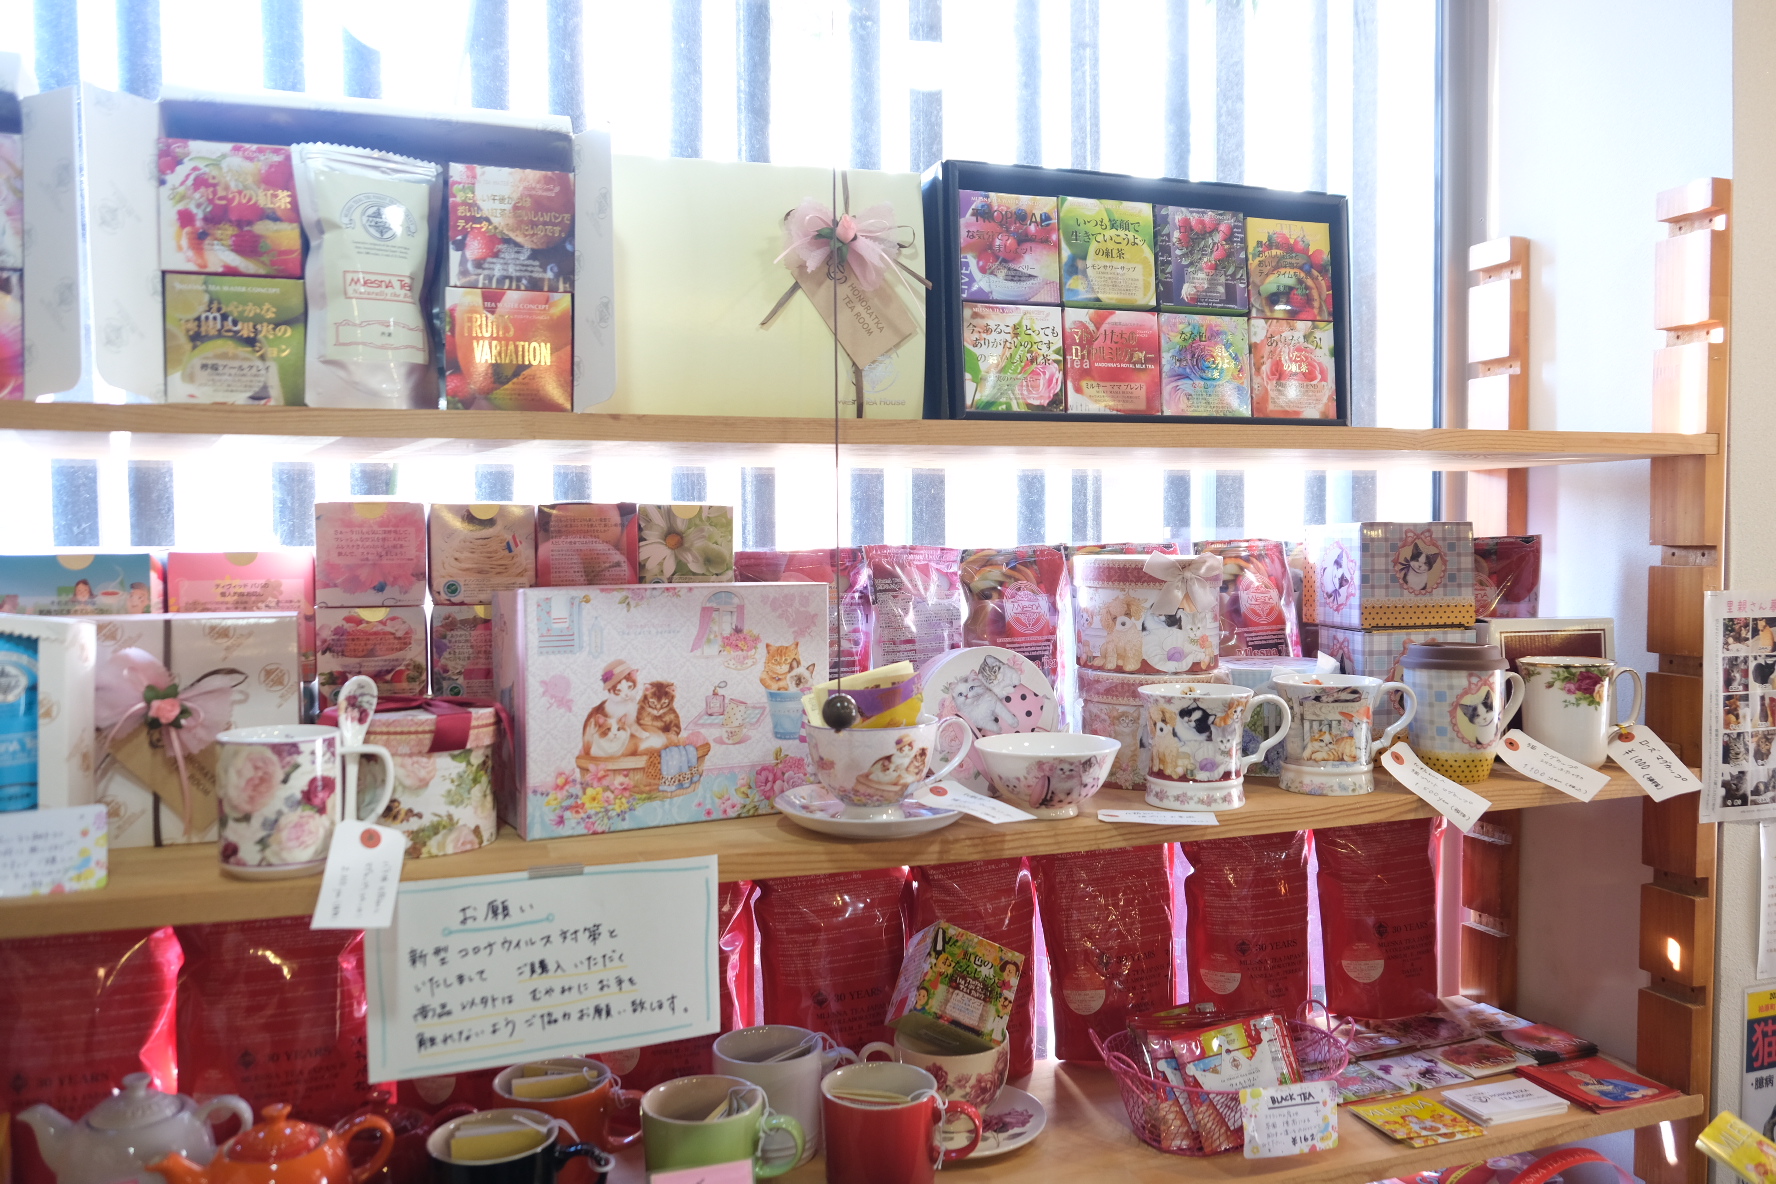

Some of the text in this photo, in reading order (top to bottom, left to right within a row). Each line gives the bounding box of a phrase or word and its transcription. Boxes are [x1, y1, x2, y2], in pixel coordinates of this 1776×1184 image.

[972, 207, 1044, 228] TROPICAL
[1076, 217, 1141, 233] いつも笑顔で
[1070, 230, 1147, 247] 生きていこうよッ
[1094, 247, 1125, 260] の紅茶
[400, 279, 412, 292] Te
[842, 294, 874, 337] TEA ROOM
[847, 283, 885, 334] HONORATKA
[463, 313, 515, 338] FRUITS
[1023, 324, 1059, 338] とっても
[972, 337, 1054, 351] ありがたいのです
[473, 339, 552, 366] VARIATION
[1065, 355, 1090, 369] Tea
[1283, 362, 1309, 373] の紅茶
[1123, 383, 1144, 391] ブレンド
[459, 899, 535, 925] お願い
[1403, 920, 1429, 932] YEARS
[1255, 938, 1298, 952] 30 YEARS
[414, 967, 488, 998] いたしまして
[834, 986, 883, 1002] 30 YEARS
[1751, 1018, 1776, 1069] 猫
[1269, 1091, 1316, 1106] BLACK TEA
[1360, 1098, 1433, 1118] MLESNA
[1291, 1132, 1316, 1147] ¥162
